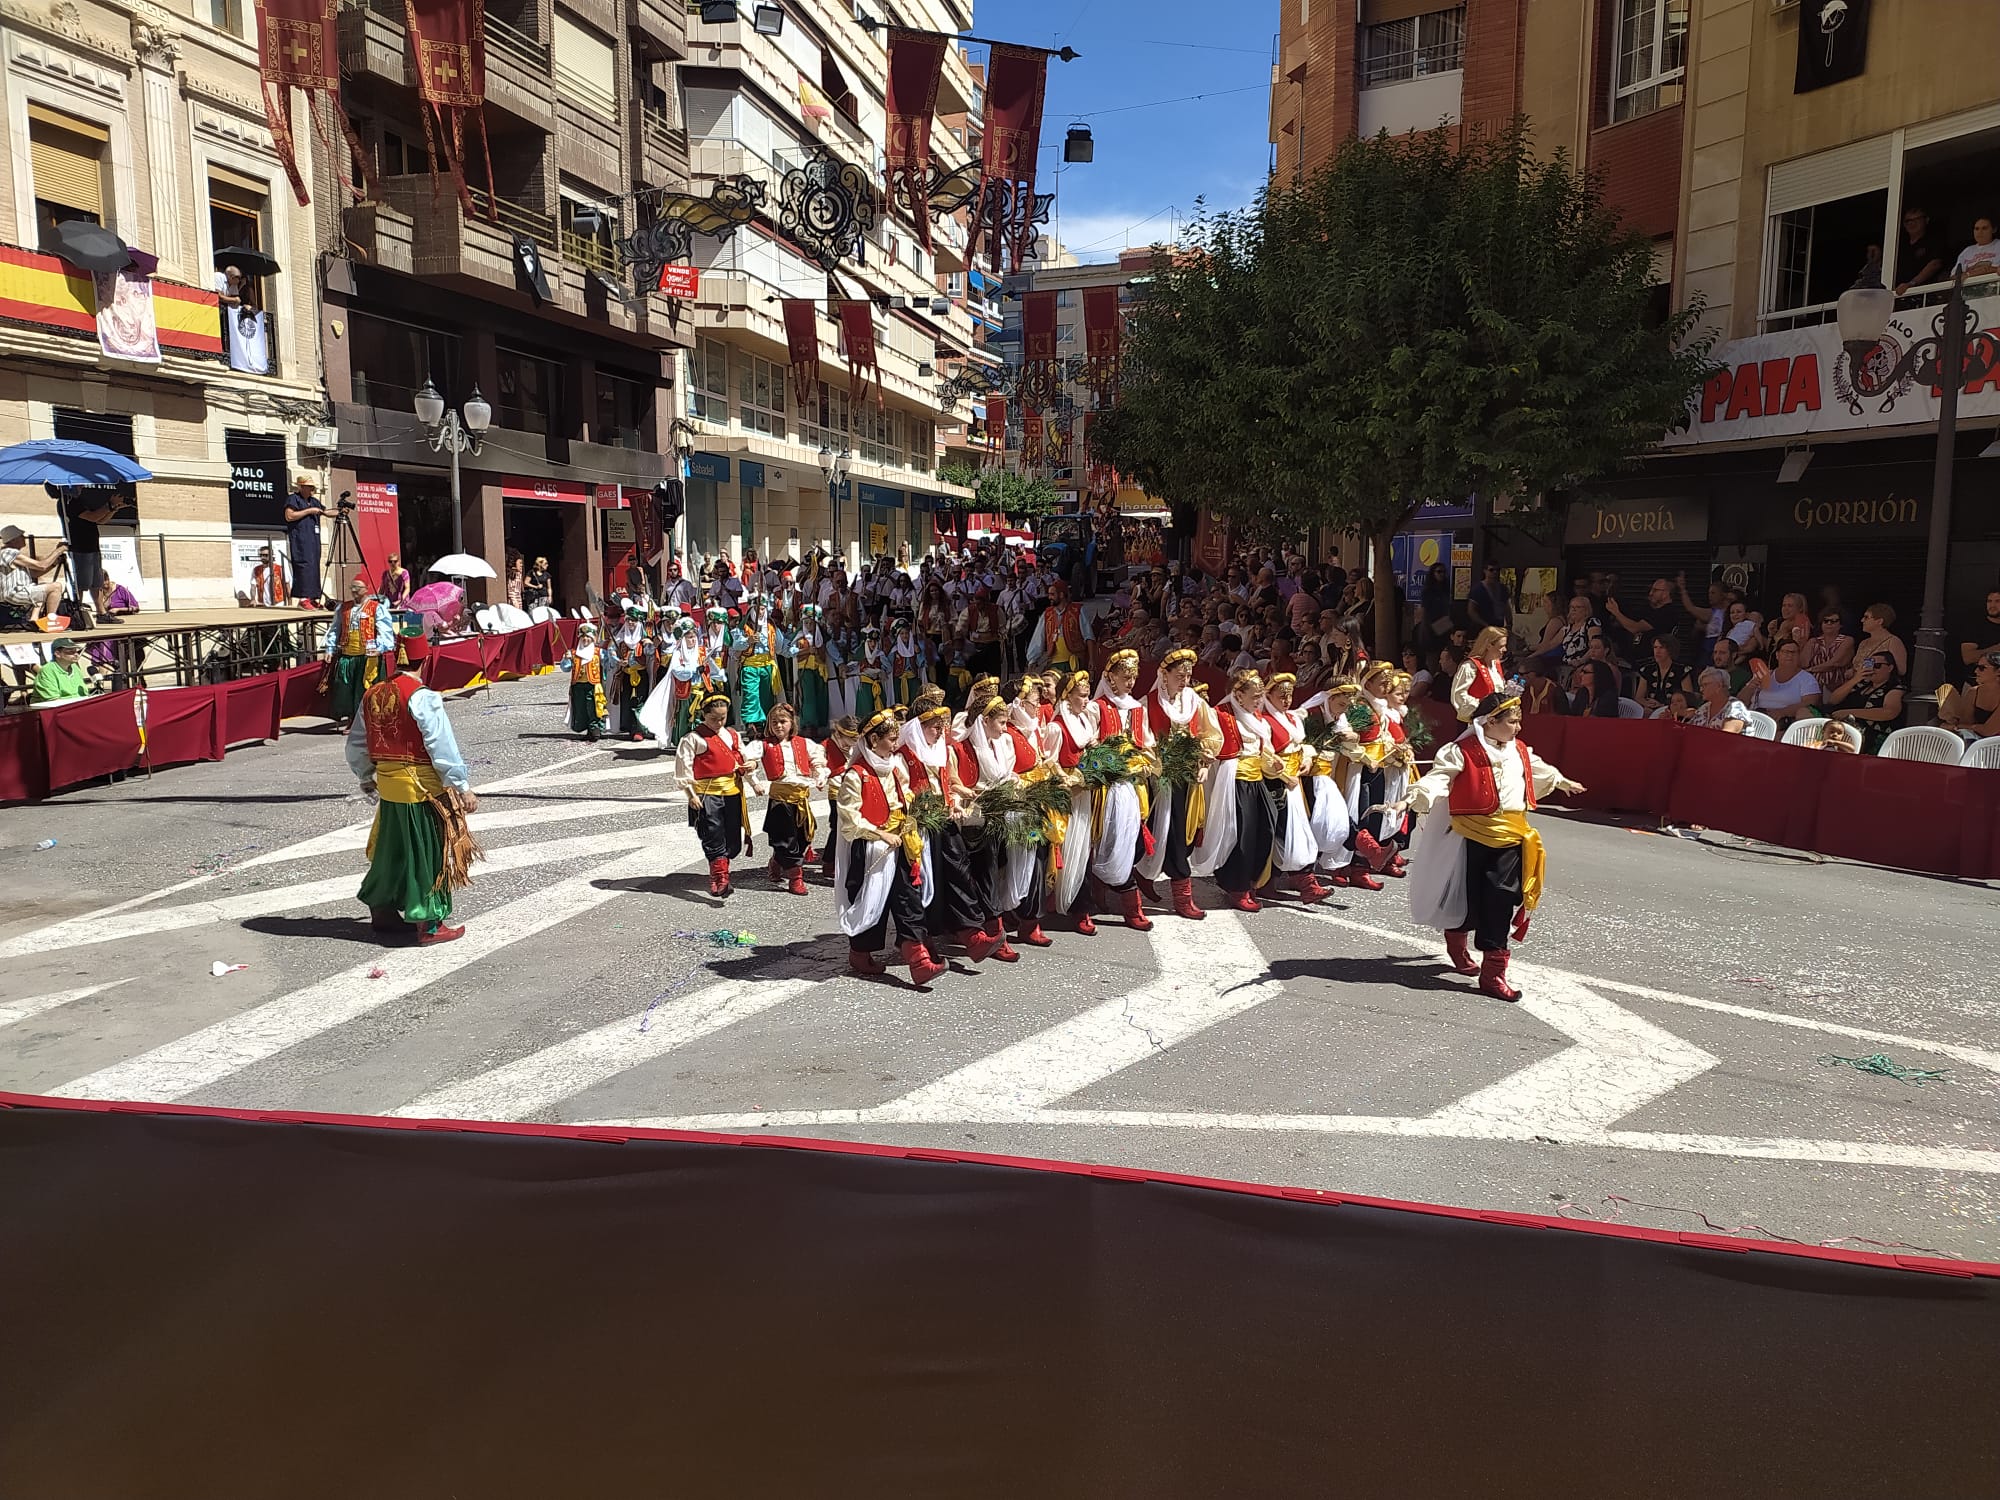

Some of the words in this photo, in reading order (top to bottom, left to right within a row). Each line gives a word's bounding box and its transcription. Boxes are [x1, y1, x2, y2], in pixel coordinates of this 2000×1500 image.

[1887, 318, 1914, 338] ALO
[1700, 353, 1822, 423] PATA
[230, 466, 264, 479] PABLO
[230, 480, 274, 492] DOMENE
[534, 482, 558, 497] GAES
[597, 490, 617, 499] GAES
